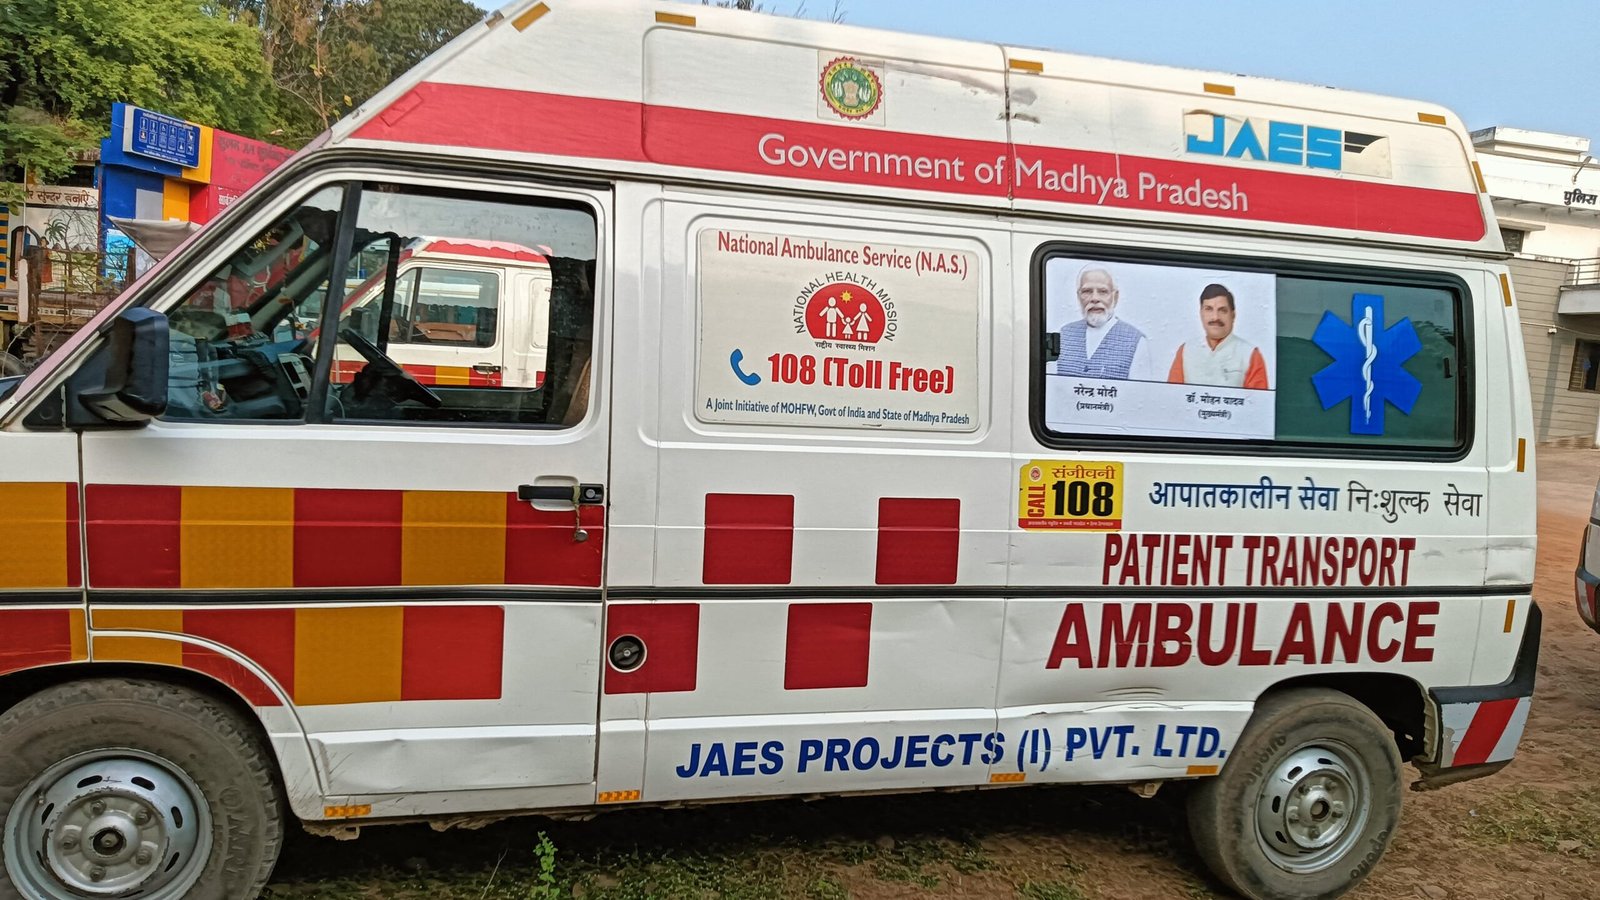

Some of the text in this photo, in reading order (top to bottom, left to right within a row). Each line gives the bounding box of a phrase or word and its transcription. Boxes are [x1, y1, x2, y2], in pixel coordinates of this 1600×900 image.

[1187, 115, 1342, 171] JAES
[758, 133, 1249, 212] Government of Madhya Pradesh
[1564, 188, 1598, 205] पुलिस
[718, 230, 968, 280] National Ambulance Service (N.A.S.)
[793, 271, 898, 341] NATIONAL HEALTH MISSION
[815, 341, 833, 349] राष्ट्रीय
[857, 343, 876, 352] मिशन
[768, 353, 955, 394] 108 (Toll Free)
[1074, 383, 1118, 398] नरेन्द्र मोदी
[706, 398, 970, 425] A Joint Initiative of MOHFW, Govt of India and State of Madhya Pradesh
[1076, 401, 1114, 413] (प्रधानमंत्री)
[1198, 409, 1231, 420] (मुख्यमंत्री)
[1200, 392, 1221, 405] मोहन
[1222, 396, 1245, 406] यादव
[1052, 465, 1116, 479] संजीवनी
[1027, 483, 1046, 517] CALL
[1052, 480, 1114, 517] 108
[1149, 476, 1291, 509] आपातकालीन
[1298, 477, 1340, 511] सेवा
[1443, 483, 1483, 517] सेवा
[1102, 533, 1416, 586] PATIENT TRANSPORT
[1045, 601, 1440, 669] AMBULANCE
[676, 724, 1227, 778] JAES PROJECTS (I) PVT. LTD.
